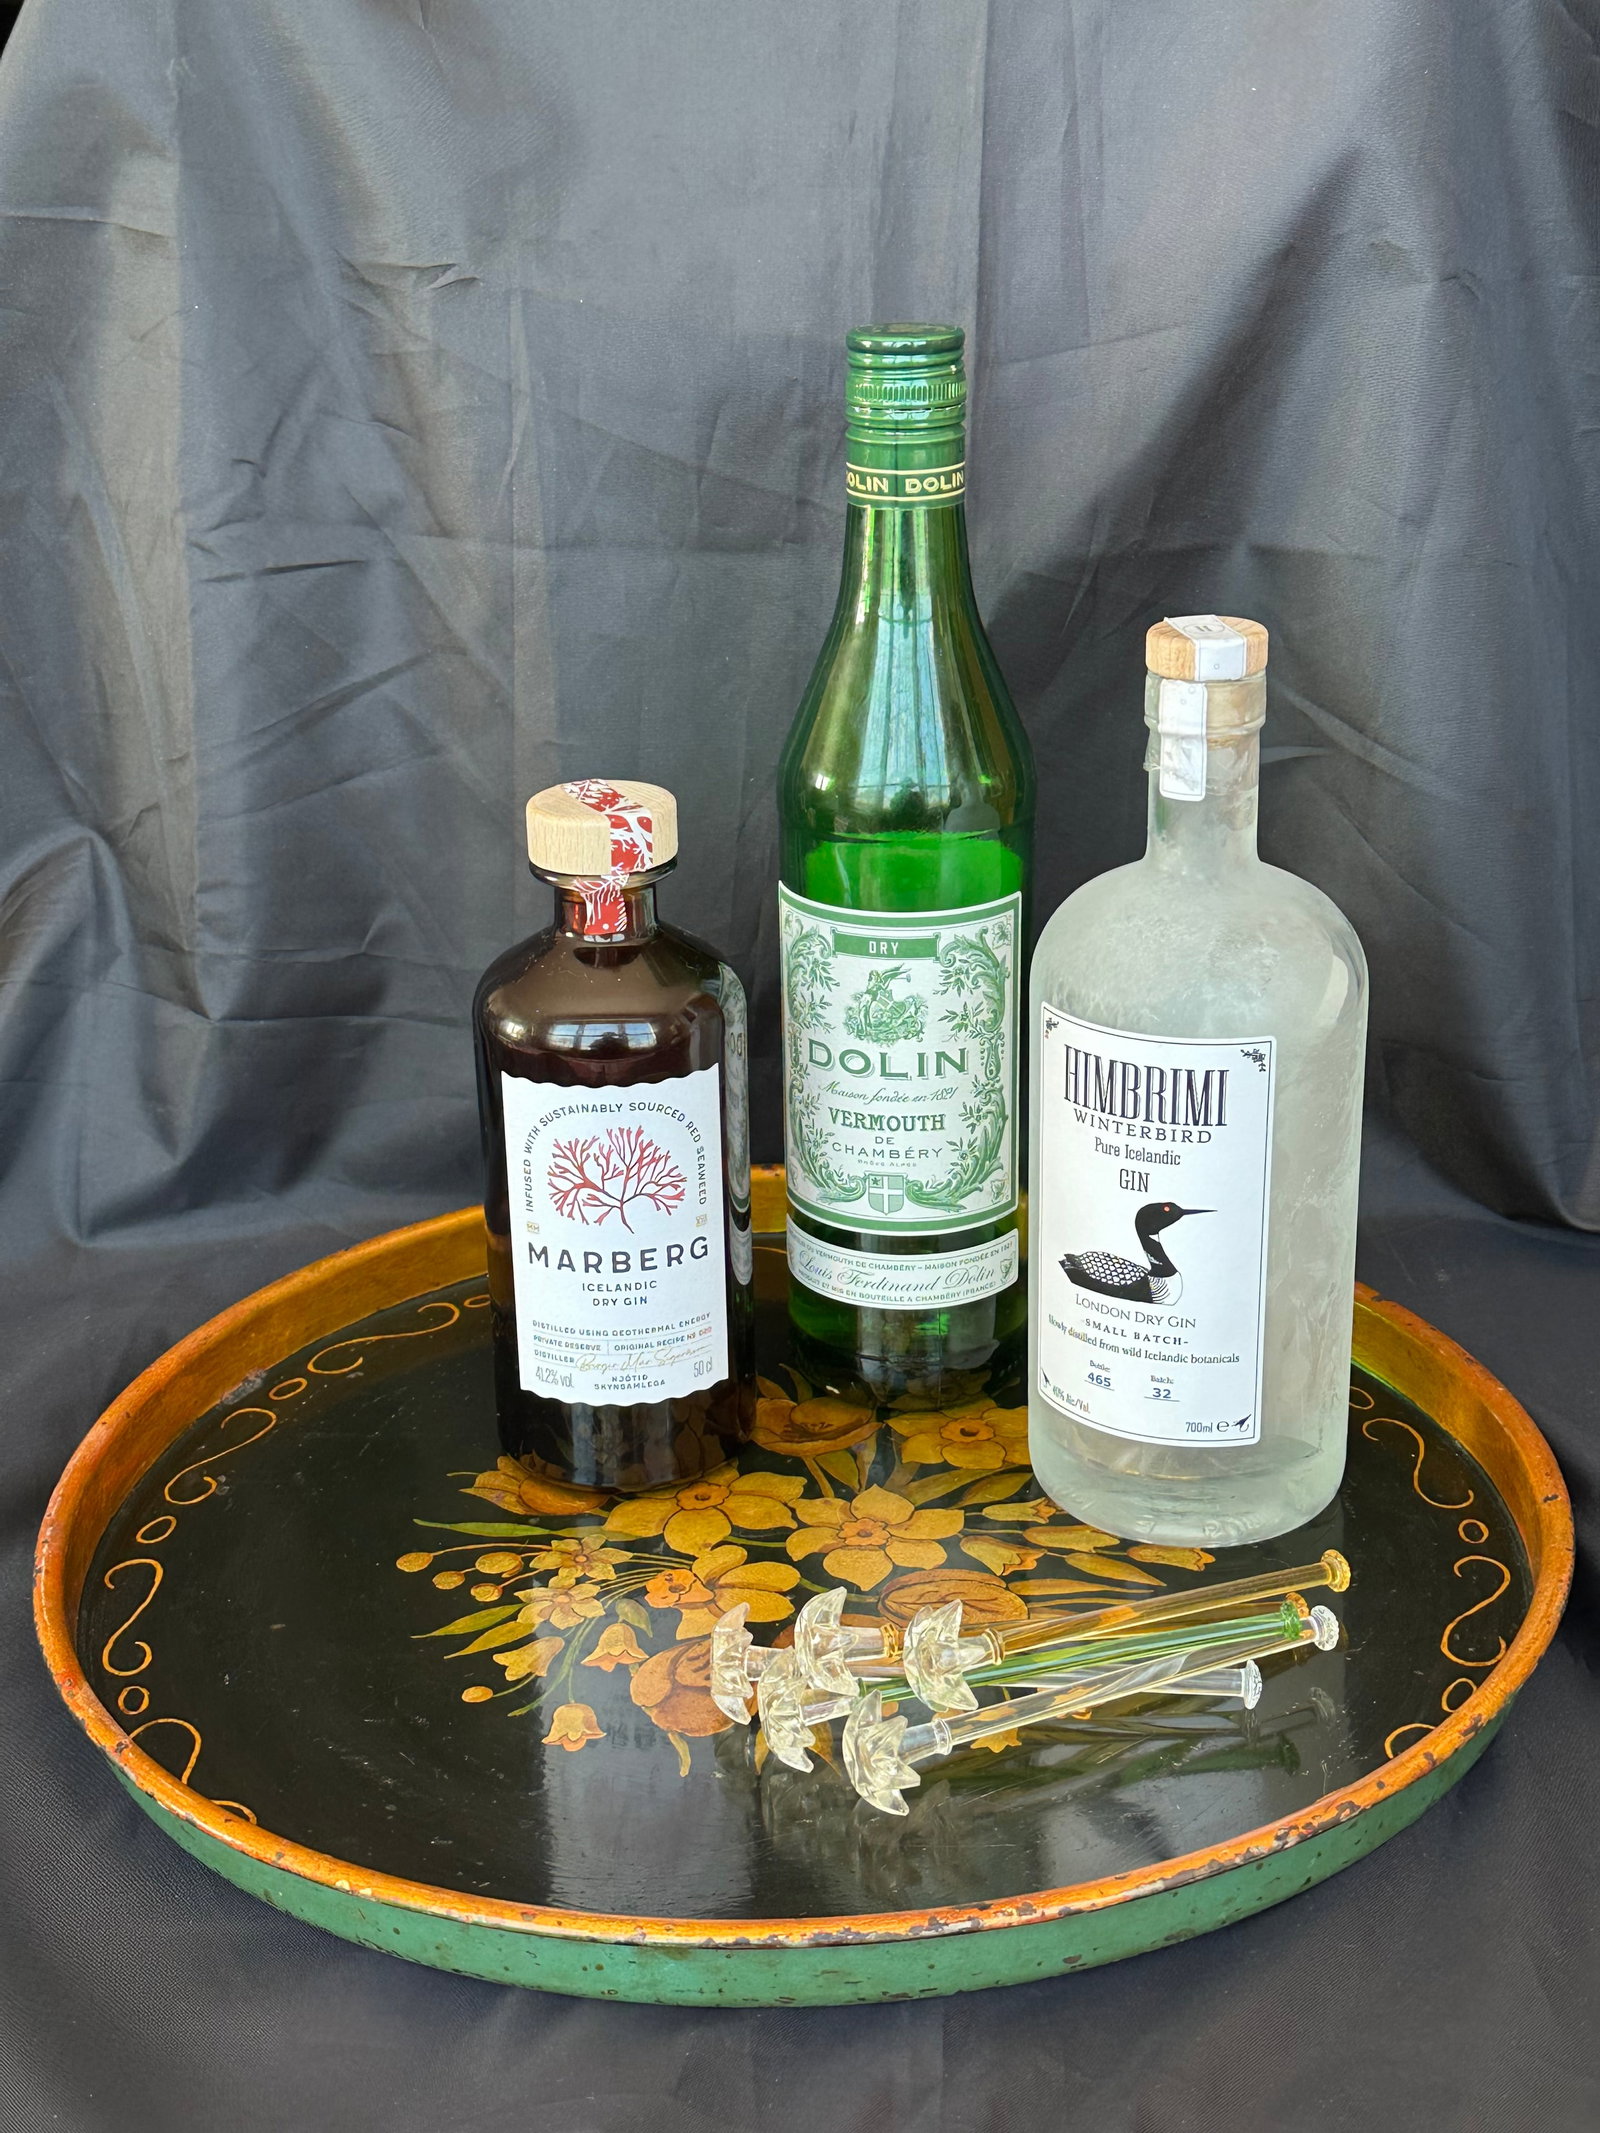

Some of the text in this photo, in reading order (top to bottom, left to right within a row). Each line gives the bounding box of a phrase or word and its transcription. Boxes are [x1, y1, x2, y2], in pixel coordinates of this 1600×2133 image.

[846, 471, 889, 493] OLIN
[905, 470, 964, 494] DOLIN
[868, 941, 899, 955] DRY
[808, 1038, 968, 1080] DOLIN
[821, 1080, 869, 1100] Maison
[864, 1088, 909, 1105] fondée
[928, 1086, 958, 1101] 1821
[1063, 1044, 1230, 1127] HIMBRIMI
[827, 1106, 946, 1132] VERMOUTH
[1073, 1108, 1212, 1144] WINTERBIRD
[832, 1142, 942, 1159] CHAMBÉRY
[875, 1136, 894, 1145] DE
[1094, 1136, 1181, 1166] Pure Icelandic
[523, 1101, 708, 1212] INFUSED WITH SUSTAINABLY SOURCED RED SEAWEED
[1119, 1168, 1150, 1193] GIN
[528, 1236, 708, 1274] MARBERG
[868, 1263, 916, 1272] CHAMBÉRY
[925, 1261, 957, 1271] MAISON
[959, 1251, 989, 1265] FONDÉE
[990, 1249, 999, 1257] EN
[799, 1250, 995, 1292] Louis Ferdinand Dolin
[582, 1280, 658, 1292] ICELANDIC
[831, 1286, 844, 1294] MIS
[859, 1292, 904, 1302] BOUTEILLE
[915, 1291, 960, 1302] CHAMBÉRY
[592, 1296, 648, 1307] DRY GIN
[1075, 1294, 1197, 1329] LONDON DRY GIN
[532, 1312, 711, 1337] DISTILLED USING GEOTHERMAL ENERGY
[533, 1334, 601, 1351] PRIVATE RESERVE
[614, 1340, 654, 1351] ORIGINAL
[656, 1334, 685, 1347] RECIPE
[1067, 1327, 1097, 1347] distilled
[1099, 1339, 1120, 1354] from
[1122, 1347, 1142, 1358] wild
[1144, 1349, 1188, 1364] Icelandic
[1190, 1353, 1240, 1364] botanicals
[534, 1349, 575, 1363] DISTILLER
[693, 1360, 704, 1377] 50
[594, 1379, 666, 1391] SKYNSAMLEGA
[1087, 1372, 1112, 1388] 465
[1152, 1387, 1172, 1399] 32
[1185, 1421, 1213, 1433] 700ml
